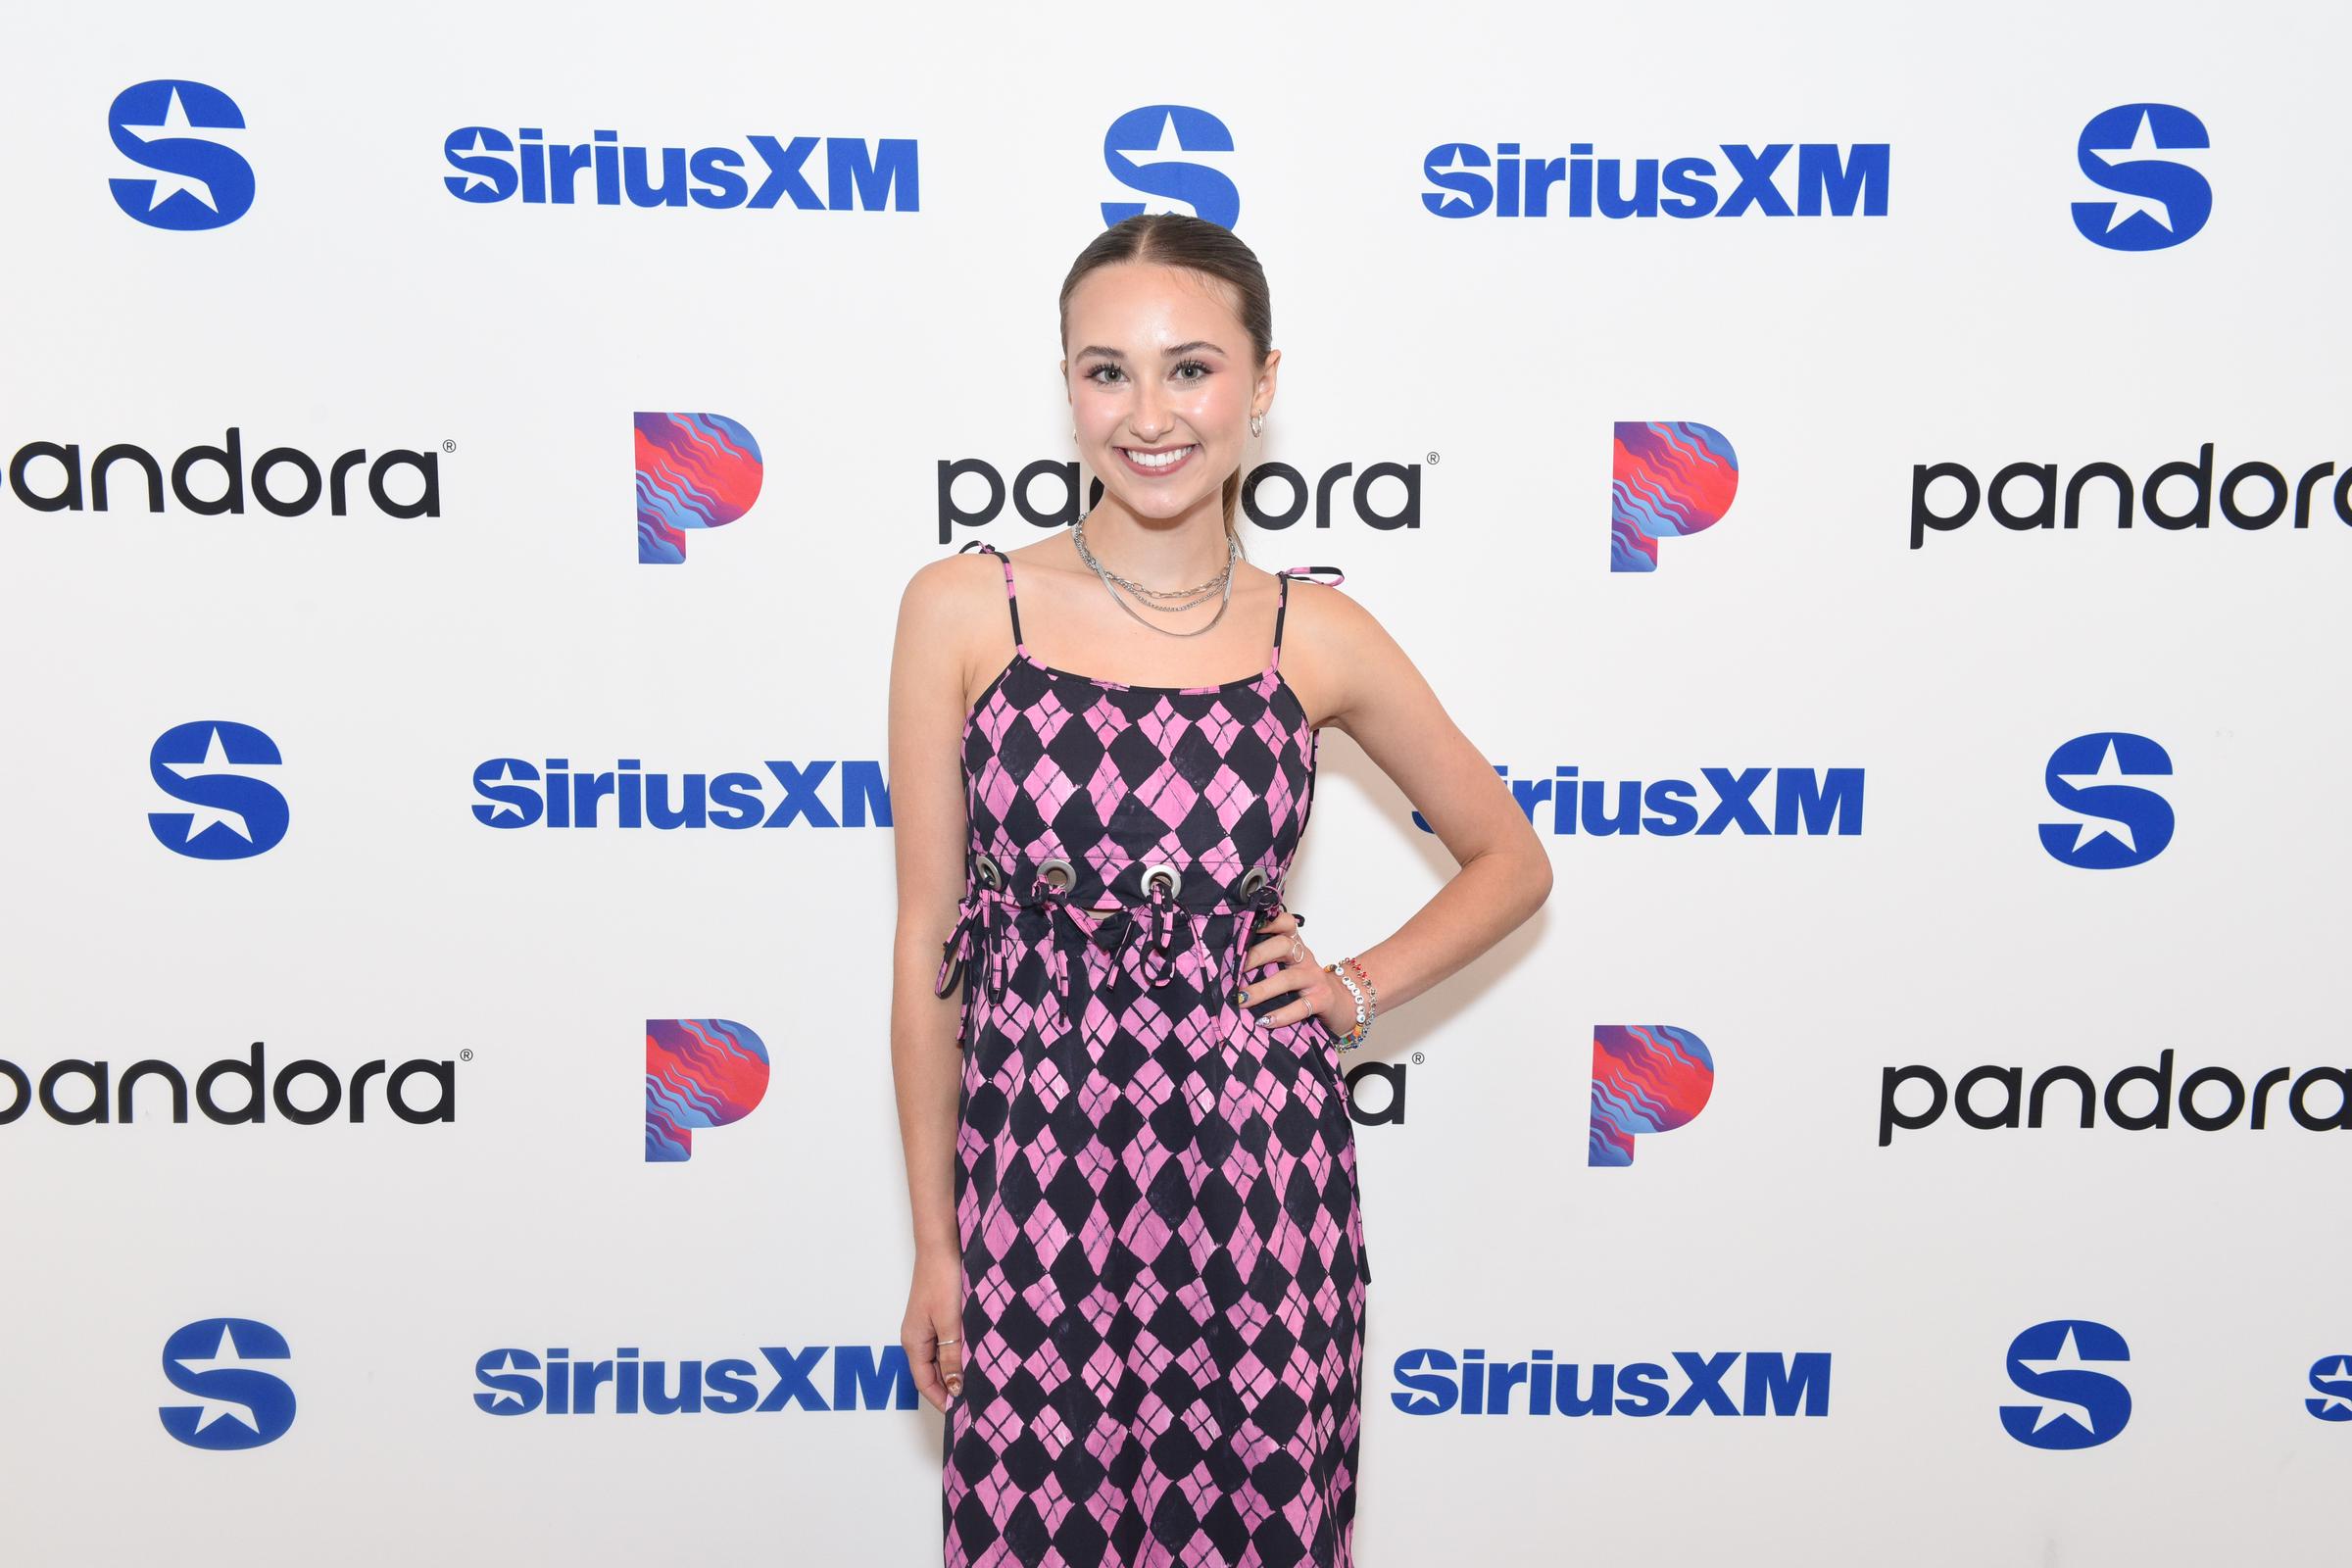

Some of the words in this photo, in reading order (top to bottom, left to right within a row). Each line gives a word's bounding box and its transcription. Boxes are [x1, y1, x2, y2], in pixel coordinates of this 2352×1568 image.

[444, 125, 919, 213] SiriusXM
[1422, 143, 1890, 219] SiriusXM
[473, 1346, 919, 1417] SiriusXM
[1391, 1348, 1832, 1418] SiriusXM
